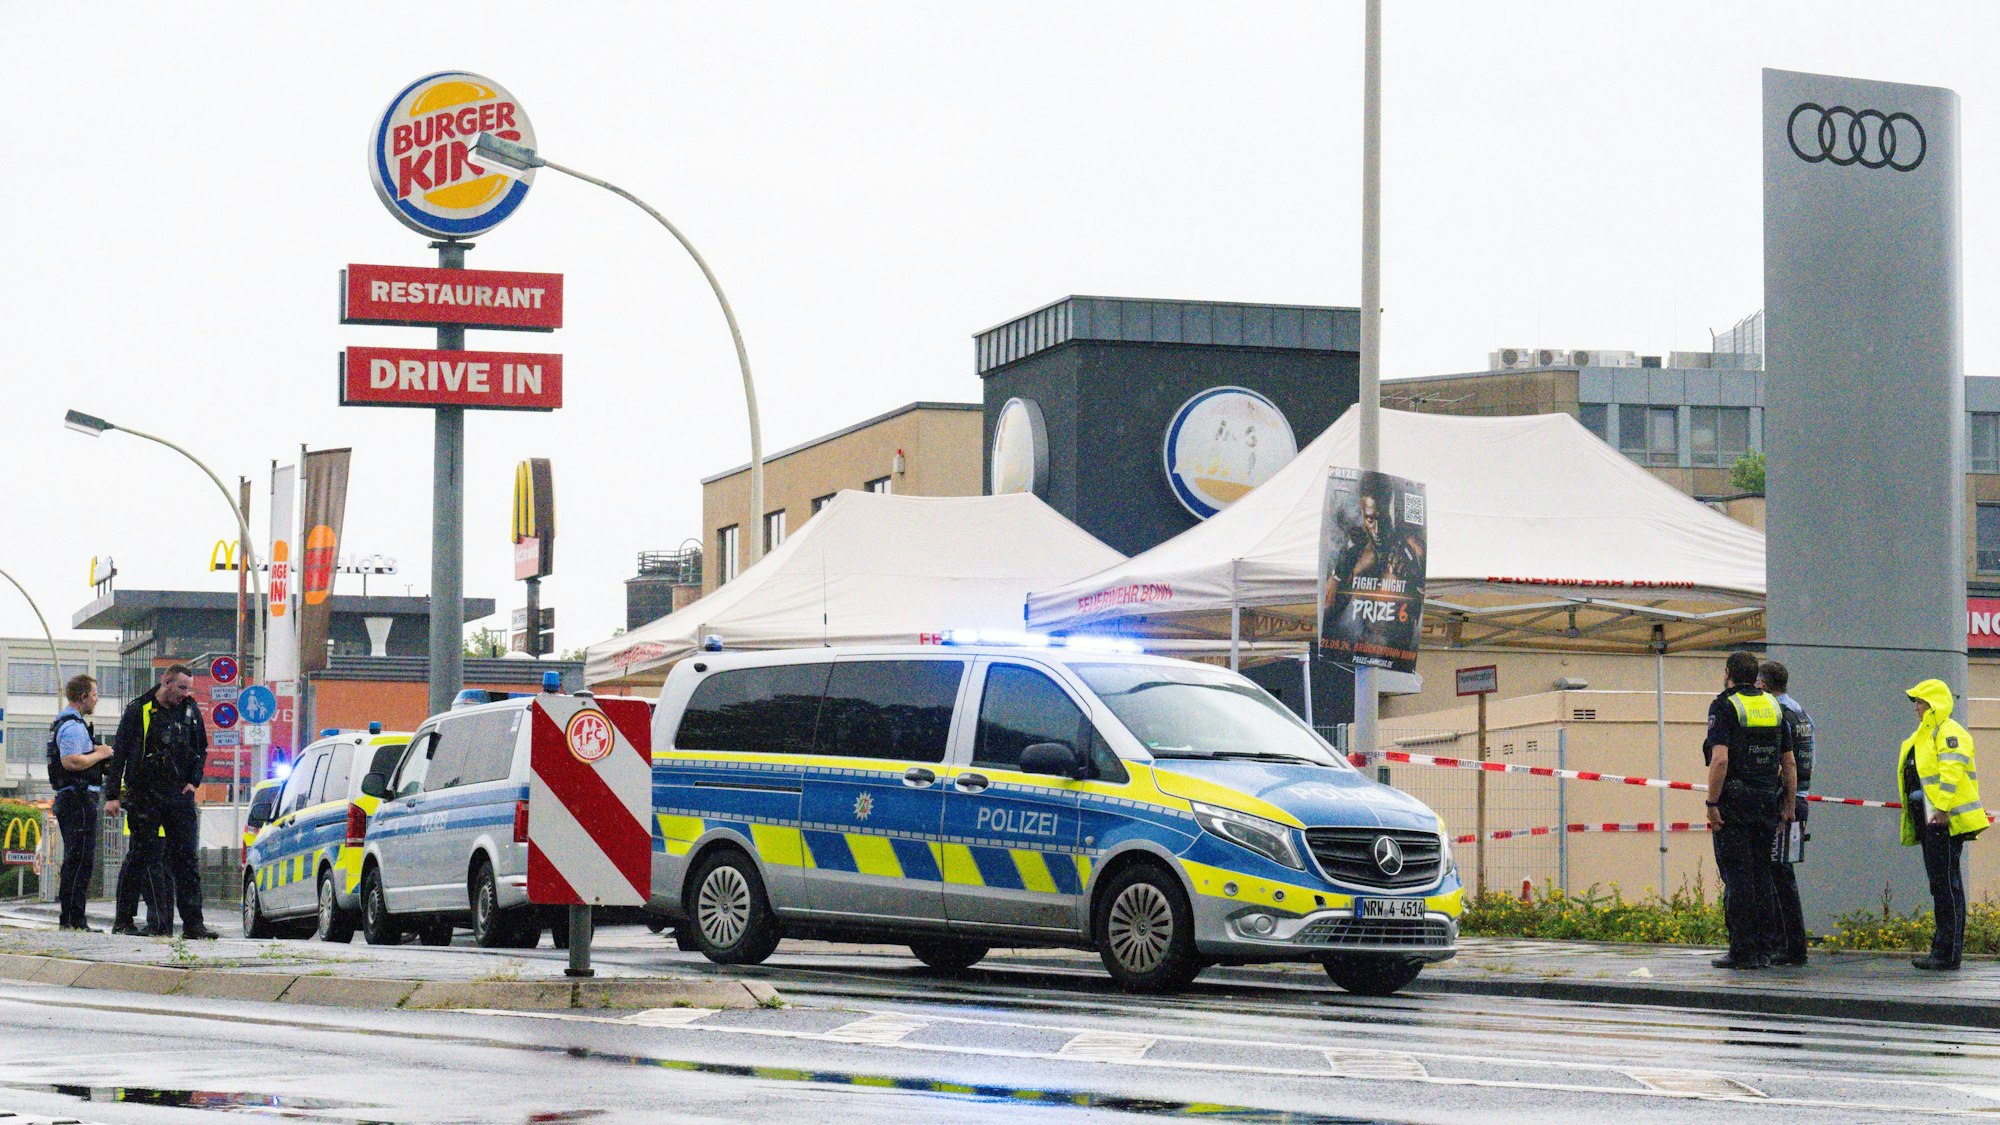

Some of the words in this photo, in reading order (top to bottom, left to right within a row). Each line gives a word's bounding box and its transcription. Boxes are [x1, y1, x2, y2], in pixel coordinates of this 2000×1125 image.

[393, 102, 516, 157] BURGER
[399, 139, 492, 200] KIN
[371, 281, 545, 309] RESTAURANT
[370, 359, 490, 393] DRIVE
[503, 364, 542, 394] IN
[1328, 468, 1358, 480] PRIZE
[1078, 585, 1138, 612] FEUERWEHR
[1141, 583, 1173, 603] BONN
[1352, 576, 1407, 593] FIGHT-NIGHT
[1352, 599, 1396, 623] PRIZE
[1399, 603, 1408, 622] 6
[1750, 708, 1775, 718] POLIZEI
[977, 807, 1058, 836] POLIZEI
[1363, 899, 1383, 916] NRW
